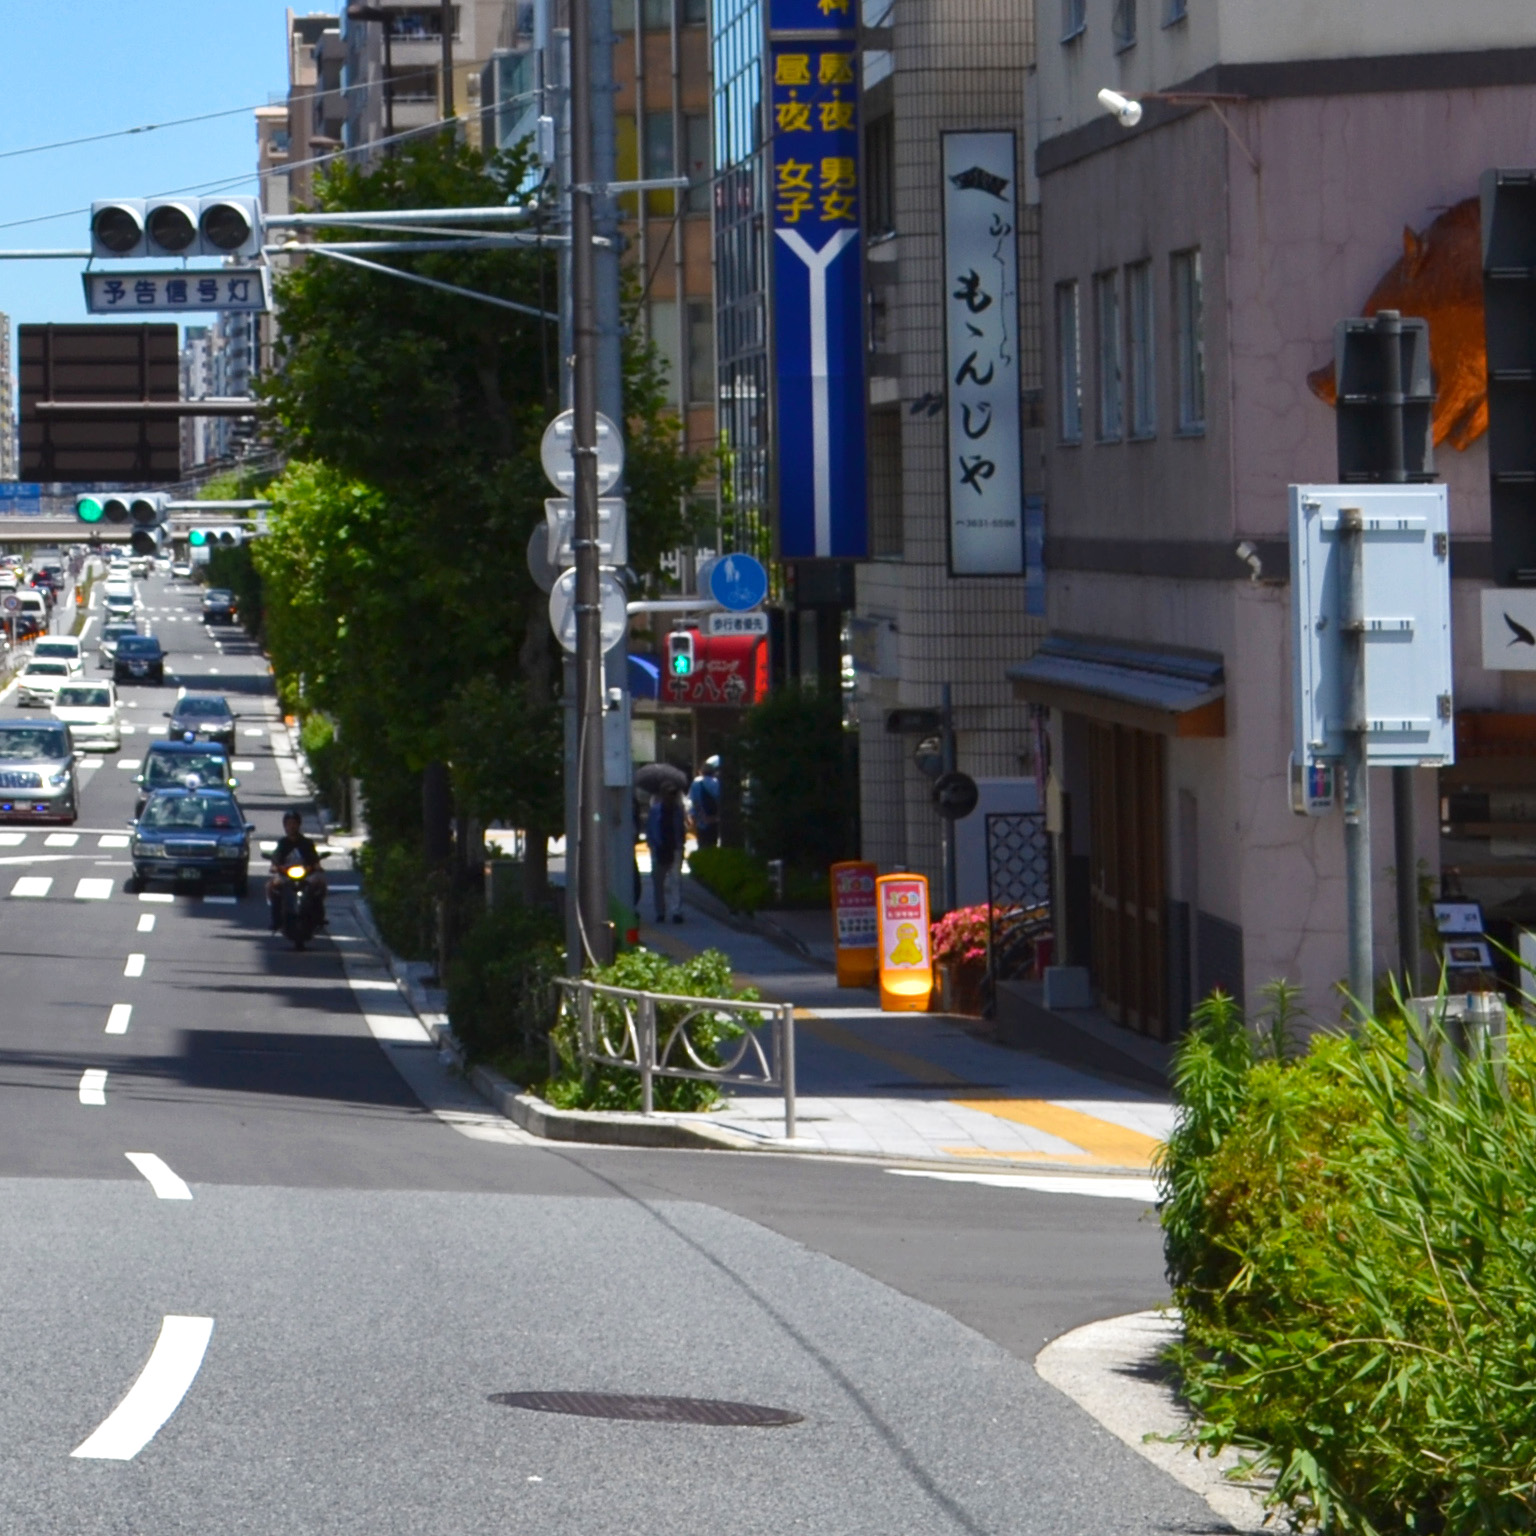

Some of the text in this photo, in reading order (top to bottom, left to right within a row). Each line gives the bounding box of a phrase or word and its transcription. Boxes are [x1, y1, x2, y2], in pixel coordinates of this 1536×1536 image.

[775, 158, 814, 223] 女子
[819, 157, 857, 222] 男女
[102, 278, 252, 306] 予告信号灯
[713, 618, 764, 631] 歩行者優先
